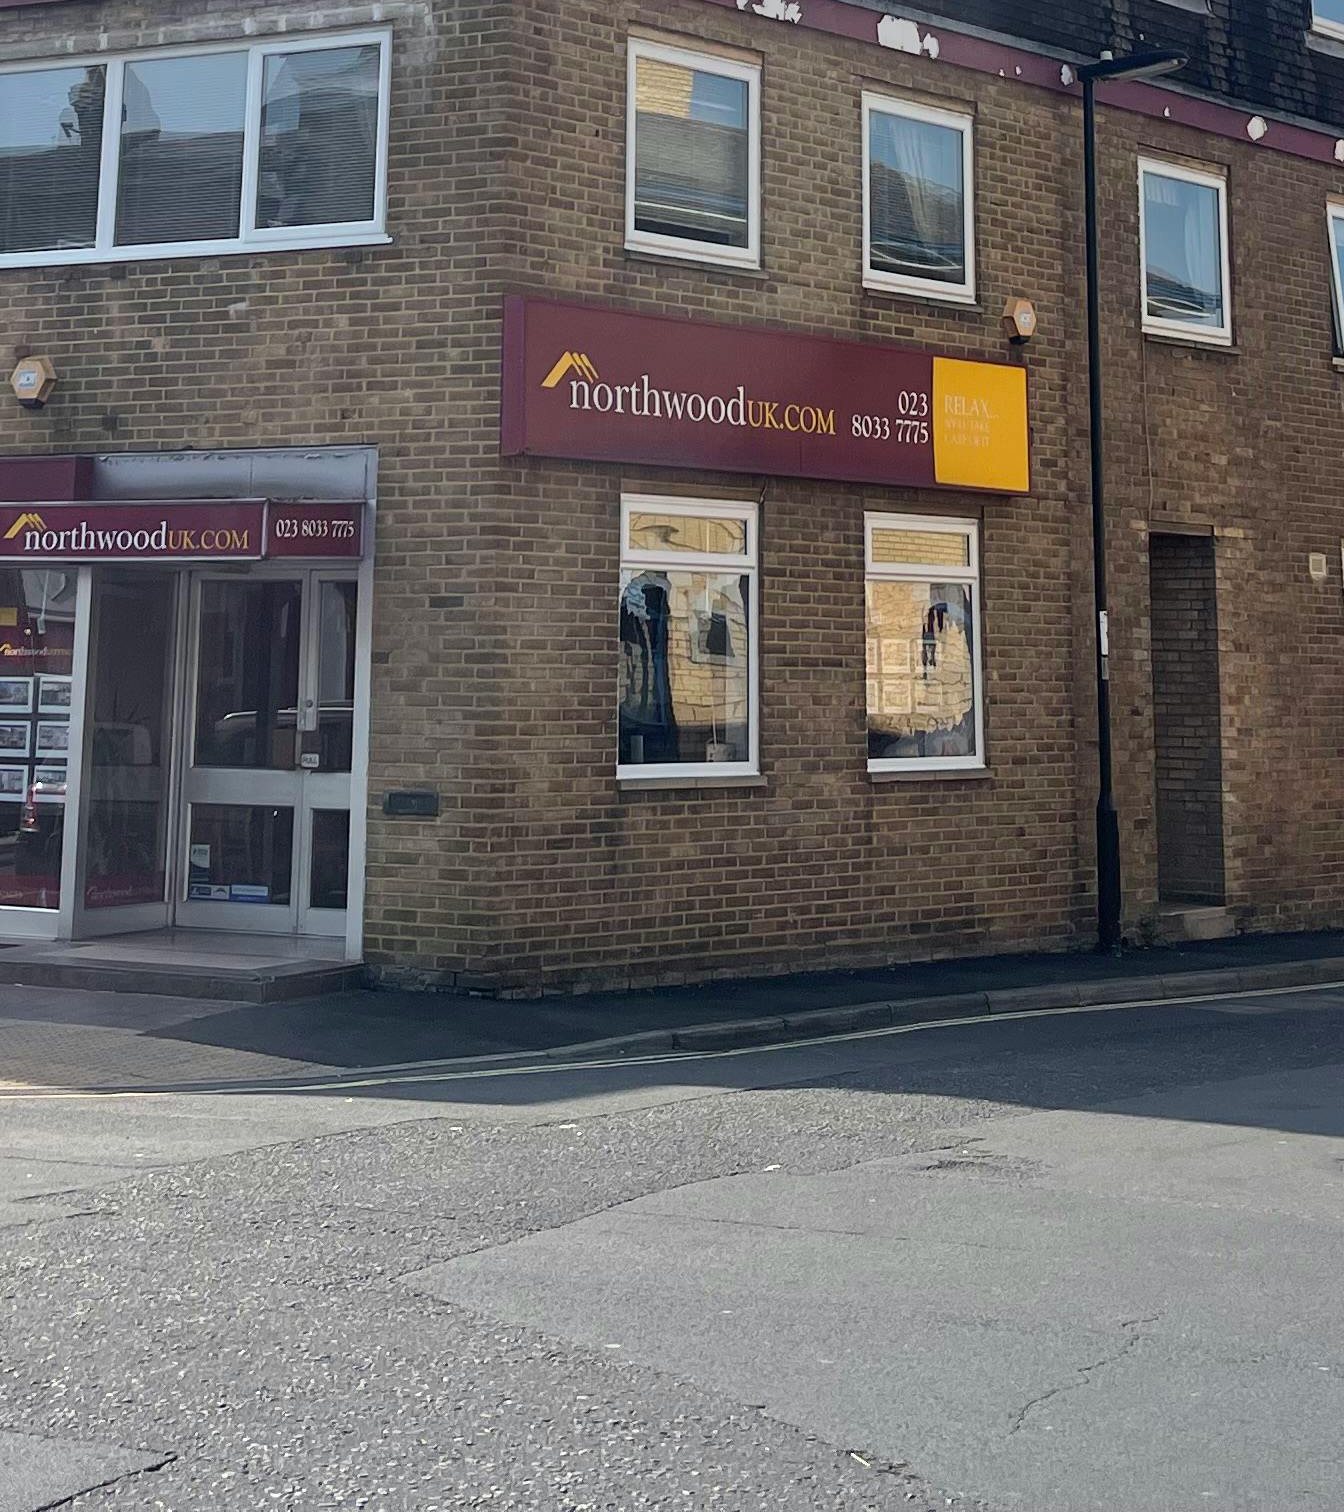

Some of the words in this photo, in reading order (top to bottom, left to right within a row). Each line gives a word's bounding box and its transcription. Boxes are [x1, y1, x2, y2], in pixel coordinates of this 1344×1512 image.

[569, 374, 836, 436] northwoodUK.COM
[897, 390, 929, 417] 023
[851, 414, 891, 440] 8033
[895, 419, 929, 445] 7775
[24, 520, 249, 551] northwoodUK.COM
[276, 519, 298, 537] 023
[301, 520, 328, 537] 8033
[331, 520, 355, 538] 7775
